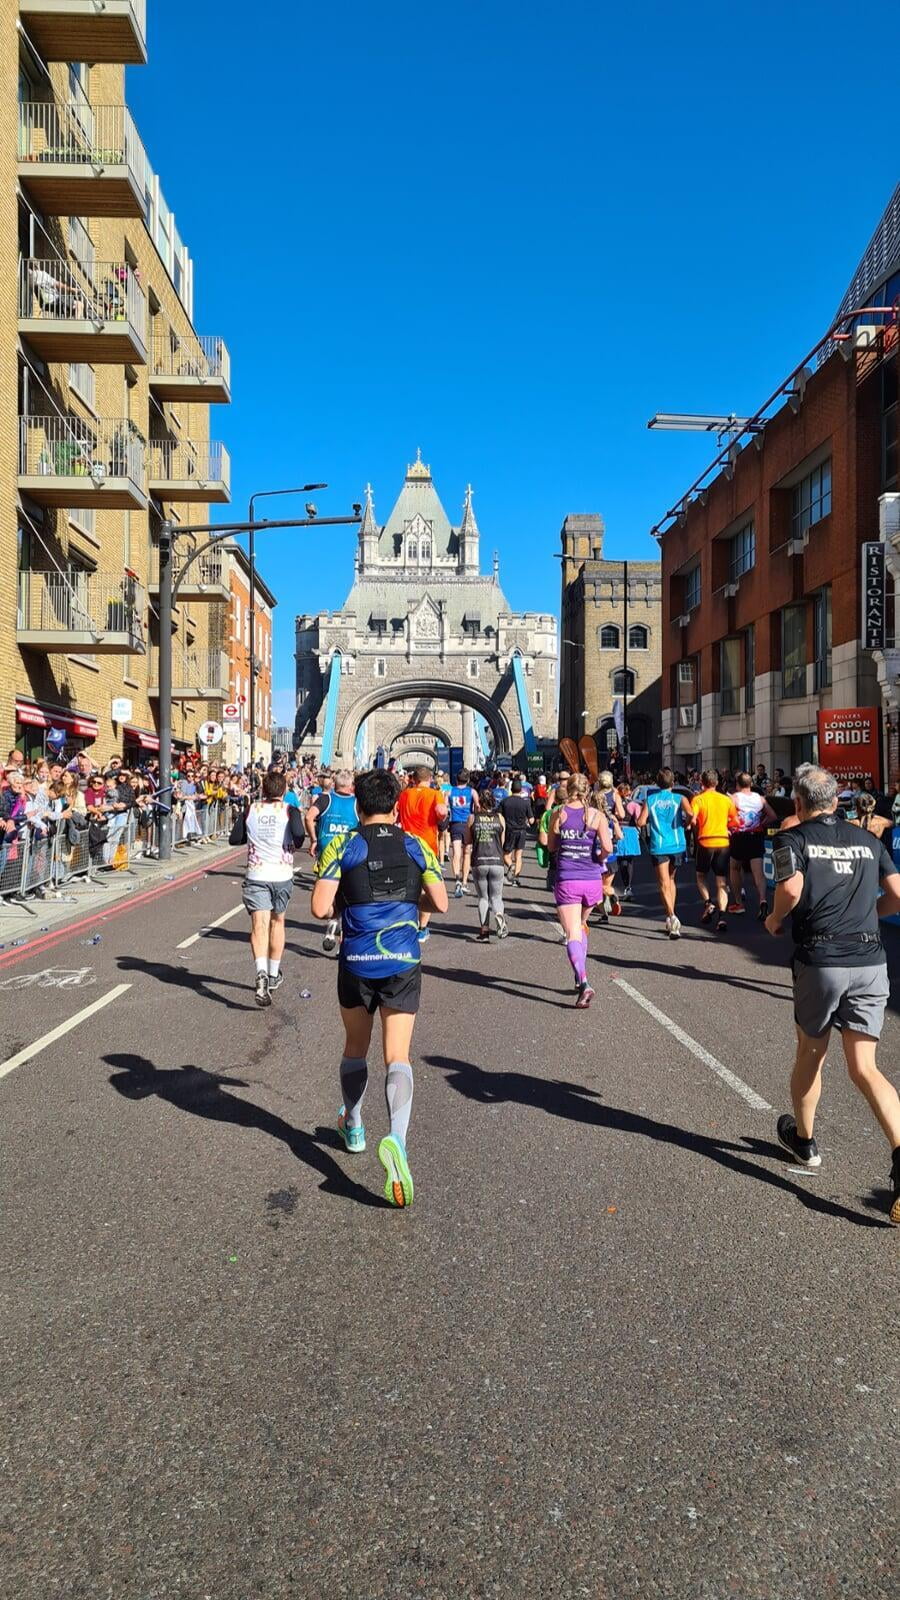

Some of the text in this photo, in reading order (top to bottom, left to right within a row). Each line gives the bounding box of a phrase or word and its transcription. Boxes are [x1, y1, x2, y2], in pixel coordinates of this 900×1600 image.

[867, 546, 882, 647] RISTORANTE
[824, 720, 871, 729] LONDON
[824, 729, 871, 745] PRIDE
[832, 772, 872, 780] ONDON
[257, 815, 277, 825] ICR
[329, 823, 349, 833] DAZ
[807, 845, 874, 860] DEMENTIA
[833, 860, 854, 874] UK
[346, 951, 412, 962] alzheimers.org.uk
